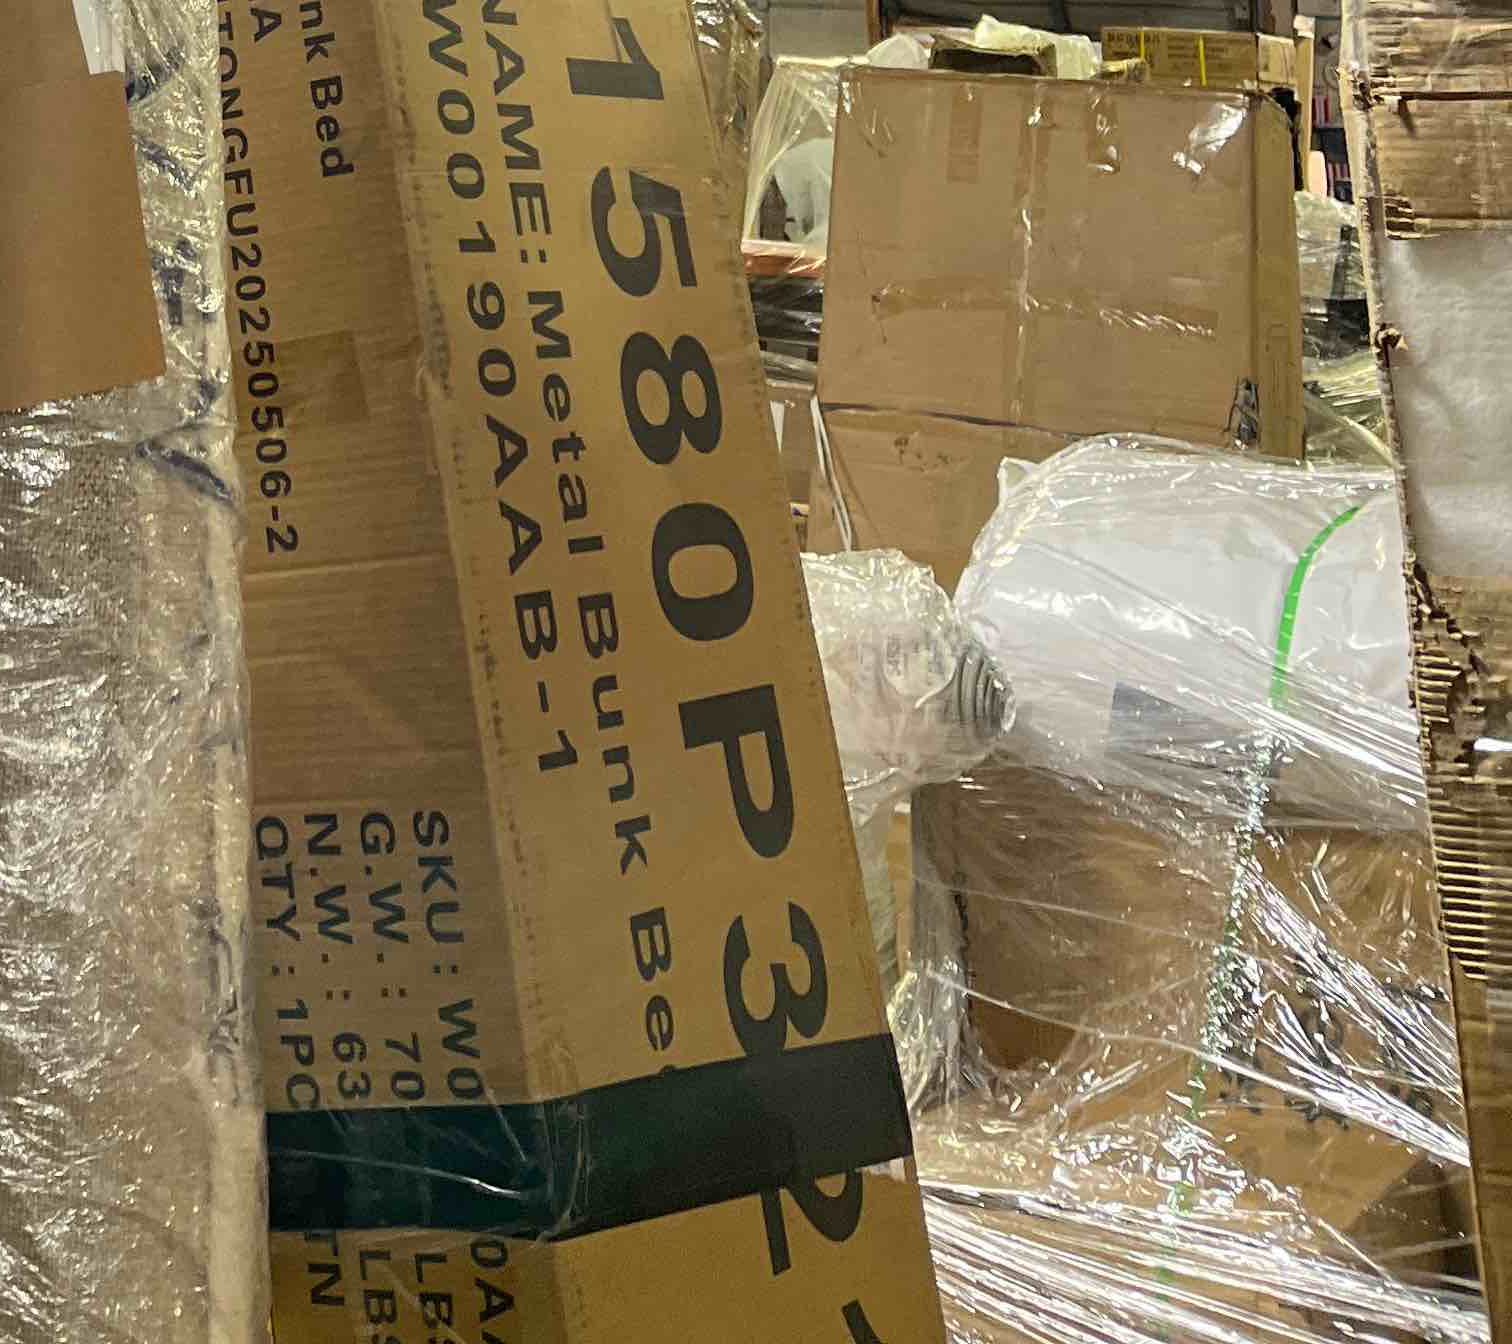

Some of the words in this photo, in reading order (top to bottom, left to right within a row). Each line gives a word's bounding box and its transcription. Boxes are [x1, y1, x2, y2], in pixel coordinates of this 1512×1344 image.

[310, 74, 354, 179] Bed
[527, 290, 605, 555] Metal
[577, 592, 652, 875] Bunk
[629, 906, 678, 1077] Be
[415, 1253, 455, 1344] LB
